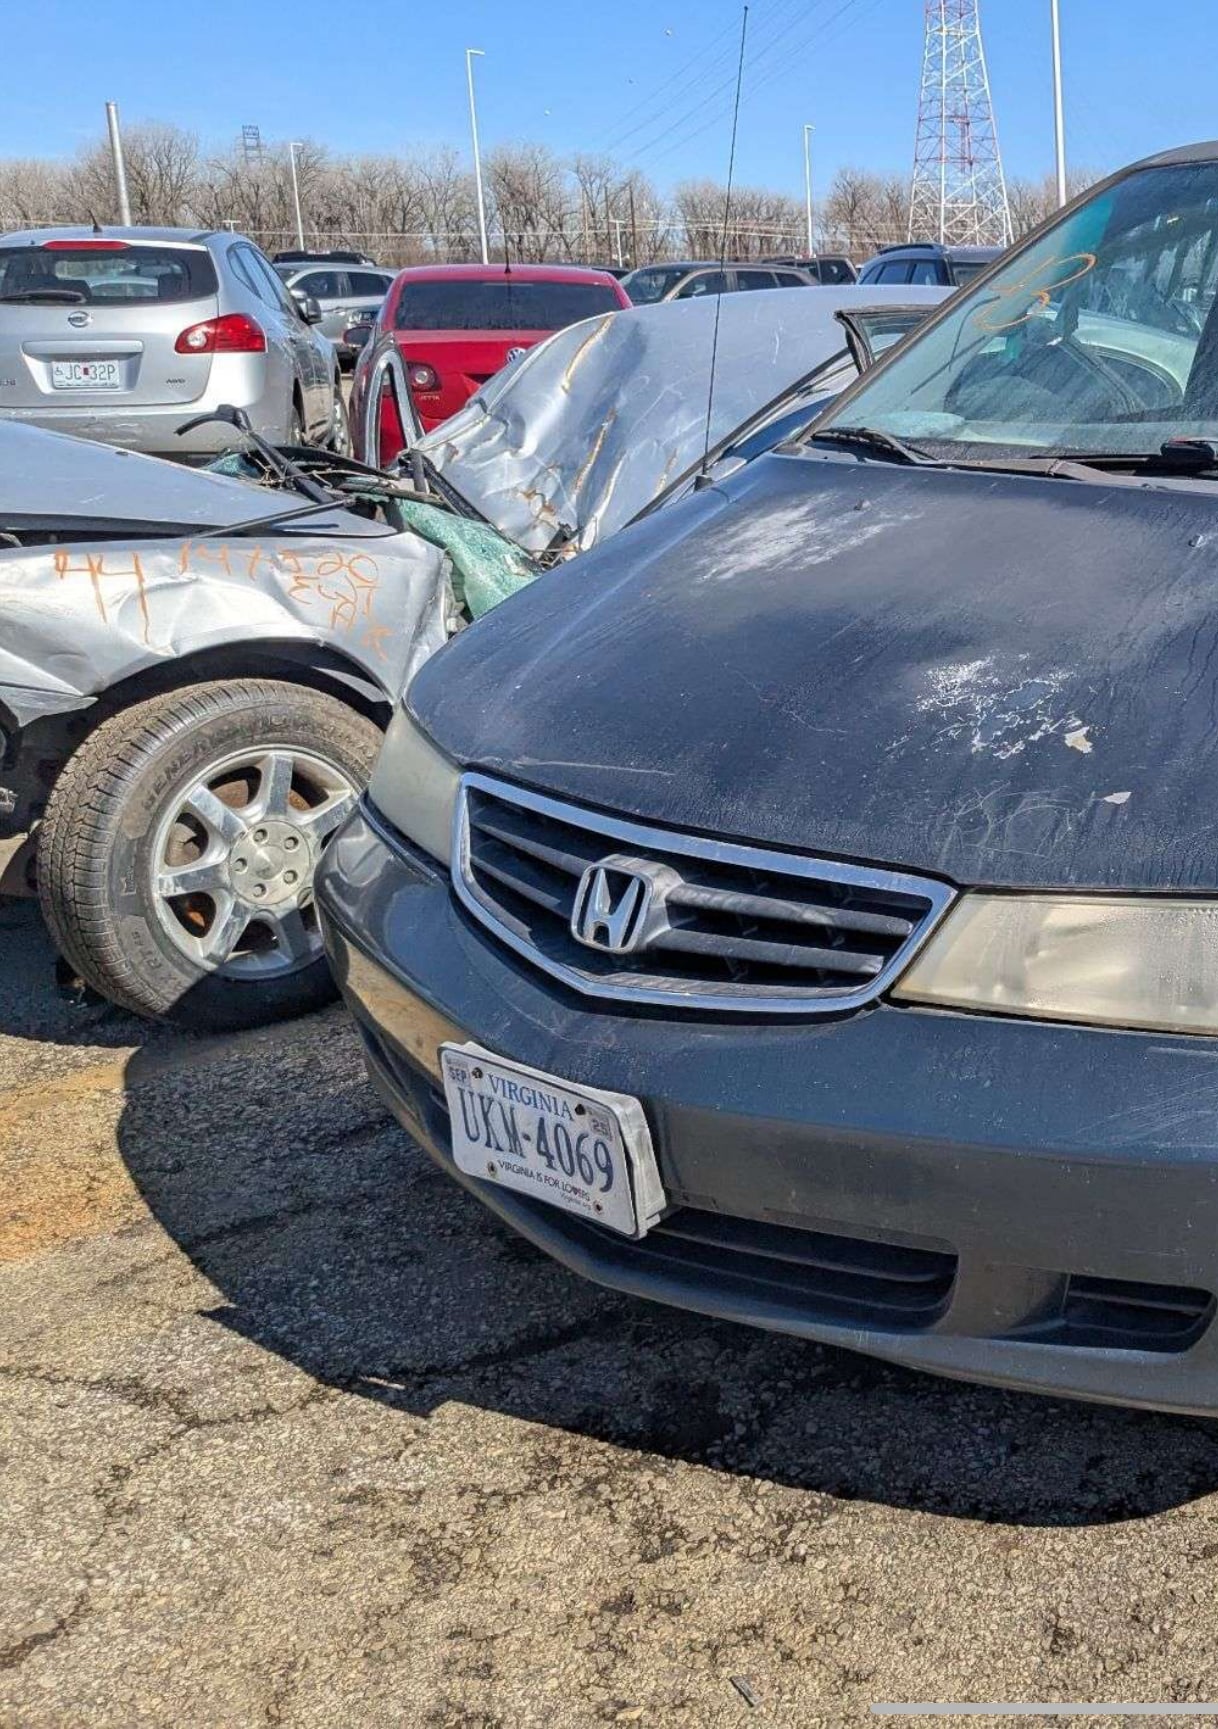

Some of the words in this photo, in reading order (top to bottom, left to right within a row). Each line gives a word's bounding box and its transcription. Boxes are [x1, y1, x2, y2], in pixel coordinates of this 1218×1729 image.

[487, 1073, 575, 1123] VIRGINIA
[497, 1159, 535, 1179] VIRGINIA
[544, 1174, 561, 1190] FOR
